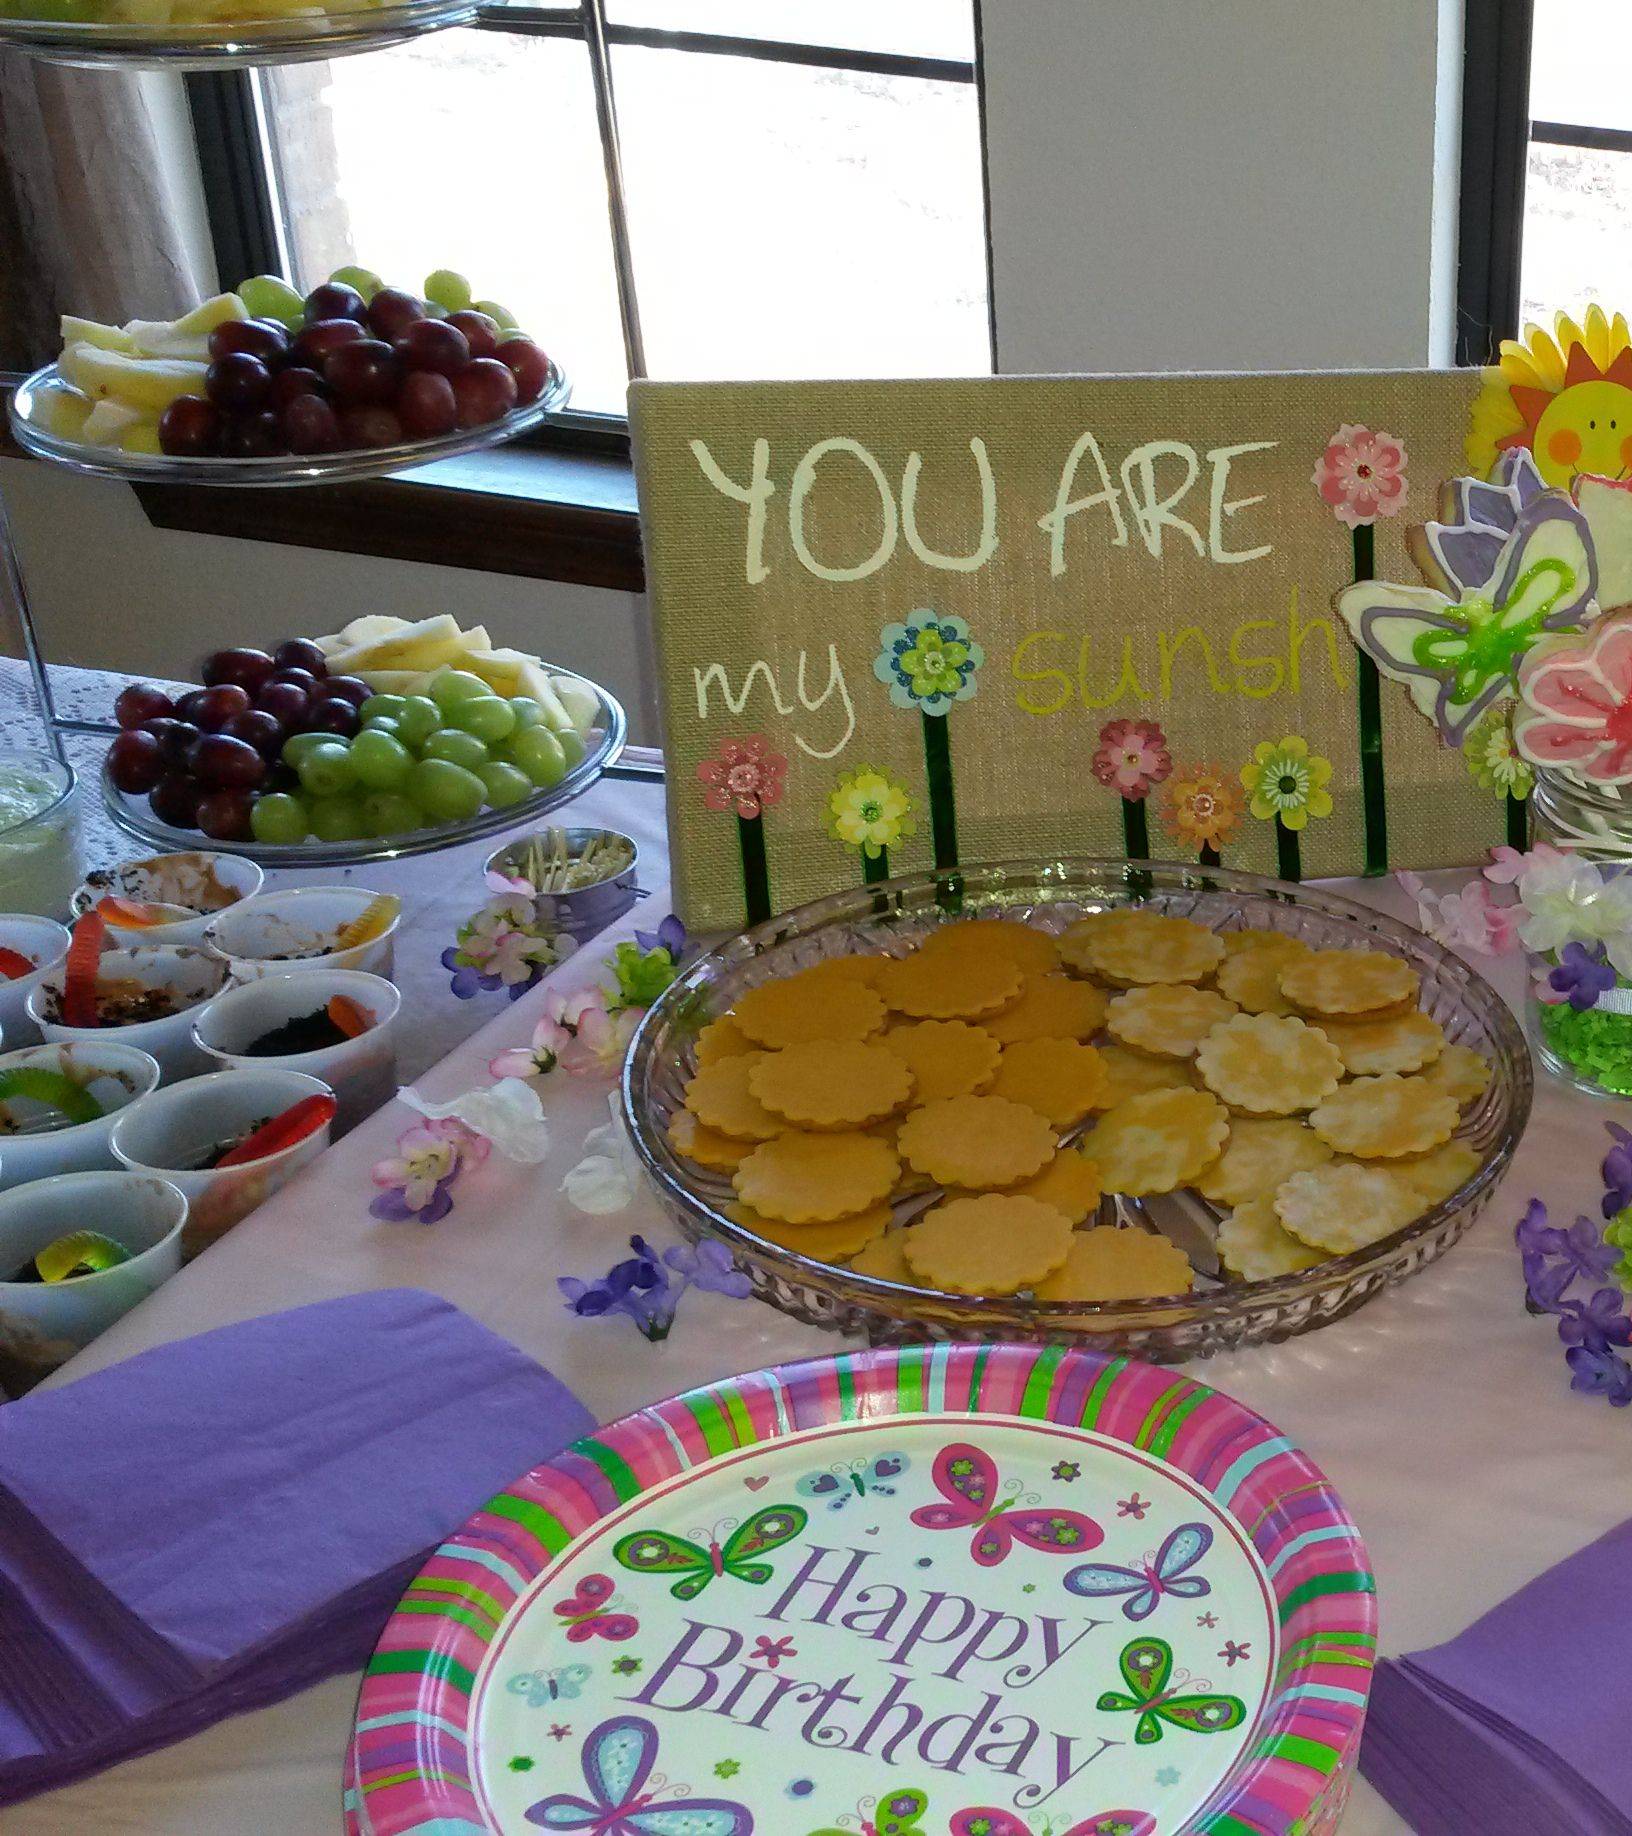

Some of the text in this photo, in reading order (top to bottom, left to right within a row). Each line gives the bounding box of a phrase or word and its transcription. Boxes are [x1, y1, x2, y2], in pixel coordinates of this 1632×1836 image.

[689, 430, 1280, 585] YOU ARE
[694, 643, 855, 760] my
[764, 1543, 1114, 1688] Happy
[613, 1617, 1127, 1808] Birthday
